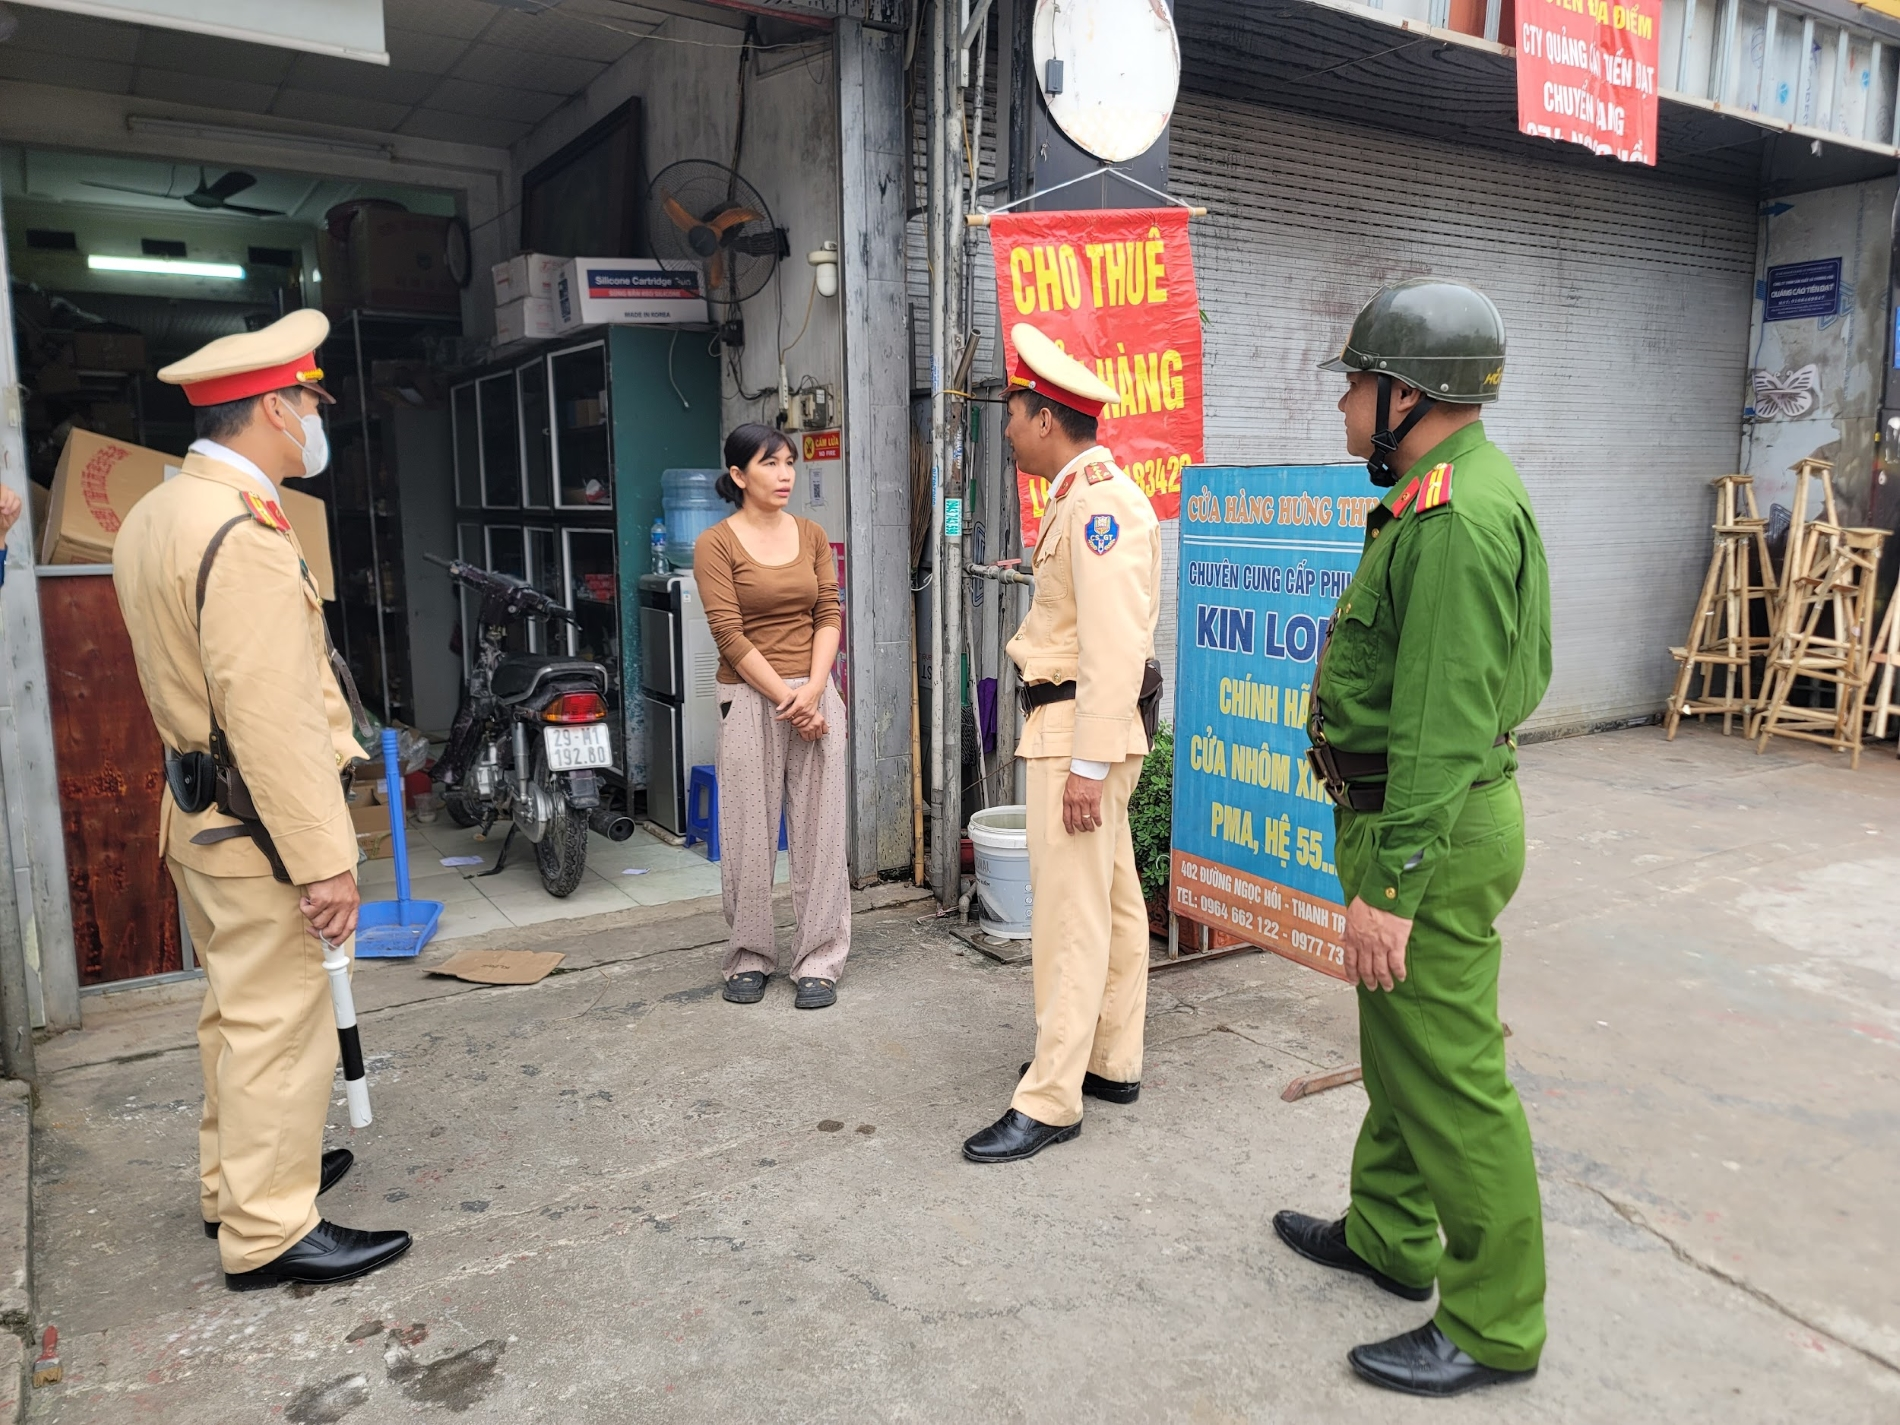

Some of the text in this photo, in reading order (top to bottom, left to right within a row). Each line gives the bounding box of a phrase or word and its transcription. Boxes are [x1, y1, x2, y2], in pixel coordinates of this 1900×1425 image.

[1612, 4, 1653, 40] ĐIỂM
[1522, 22, 1543, 58] CTY
[1545, 26, 1588, 70] QUẢNG
[1543, 79, 1594, 124] CHUYỂN
[595, 275, 631, 286] Silicone
[632, 276, 673, 288] Cartridge
[1009, 225, 1168, 316] CHO THUÊ
[1771, 287, 1793, 299] QUẢNG
[1792, 286, 1806, 296] CÁO
[1819, 282, 1835, 292] ĐẠT
[624, 311, 643, 319] MADE
[650, 311, 671, 319] KOREA
[1187, 485, 1221, 523] CỬA
[1224, 488, 1275, 525] HÀNG
[1277, 491, 1333, 527] HƯNG
[1189, 558, 1239, 590] CHUYÊN
[1243, 564, 1281, 594] CUNG
[1285, 559, 1316, 597] CẤP
[1196, 604, 1254, 655] KIN
[1219, 673, 1311, 730] CHÍNH HÃ
[554, 745, 606, 767] 192.80
[1190, 725, 1227, 777] CỬA
[1231, 742, 1290, 795] NHÔM
[1211, 801, 1260, 855] PMA,
[1264, 813, 1290, 868] HỆ
[1181, 860, 1198, 881] 402
[1200, 866, 1232, 893] ĐƯỜNG
[1234, 878, 1262, 904] NGỌC
[1264, 885, 1282, 911] HỒI
[1291, 898, 1329, 928] THANH
[1331, 911, 1346, 934] TR
[1176, 886, 1198, 908] TEL:
[1200, 895, 1228, 919] 0964
[1231, 908, 1253, 930] 662
[1257, 916, 1280, 940] 122
[1291, 929, 1324, 957] 0977
[1327, 942, 1345, 965] 73
